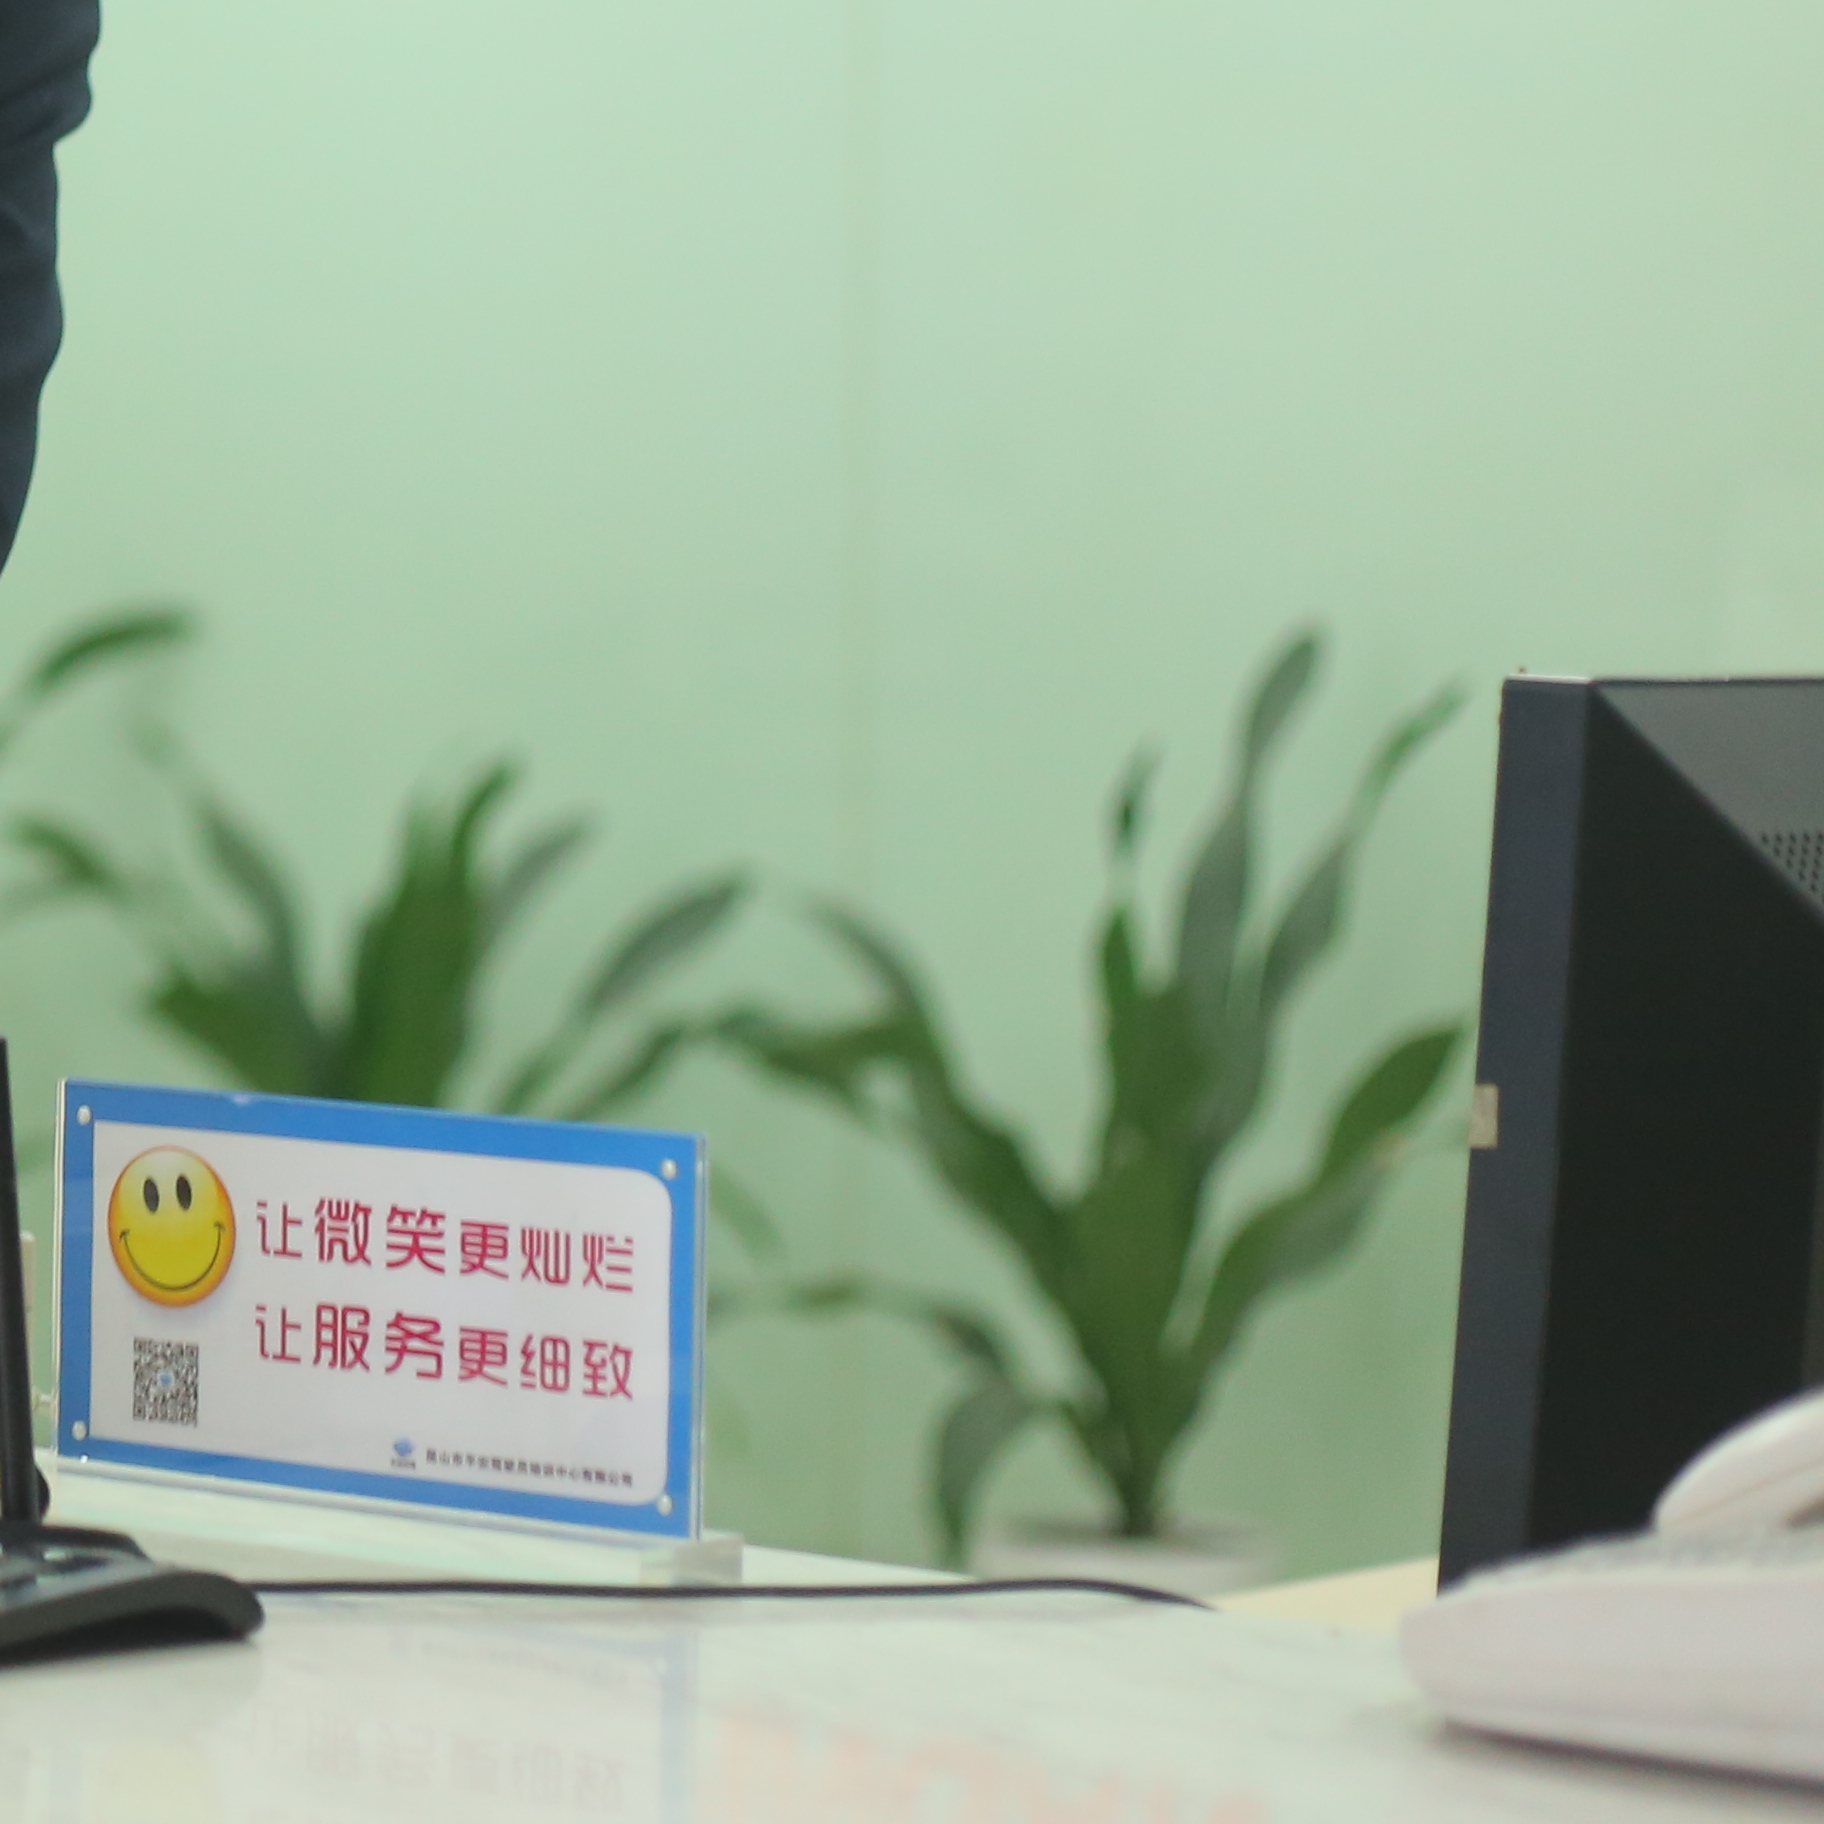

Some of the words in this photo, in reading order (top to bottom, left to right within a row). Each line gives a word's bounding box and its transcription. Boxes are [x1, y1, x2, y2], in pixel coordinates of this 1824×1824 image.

[256, 1198, 634, 1292] 让微笑更灿烂
[255, 1302, 634, 1398] 让服务更细致
